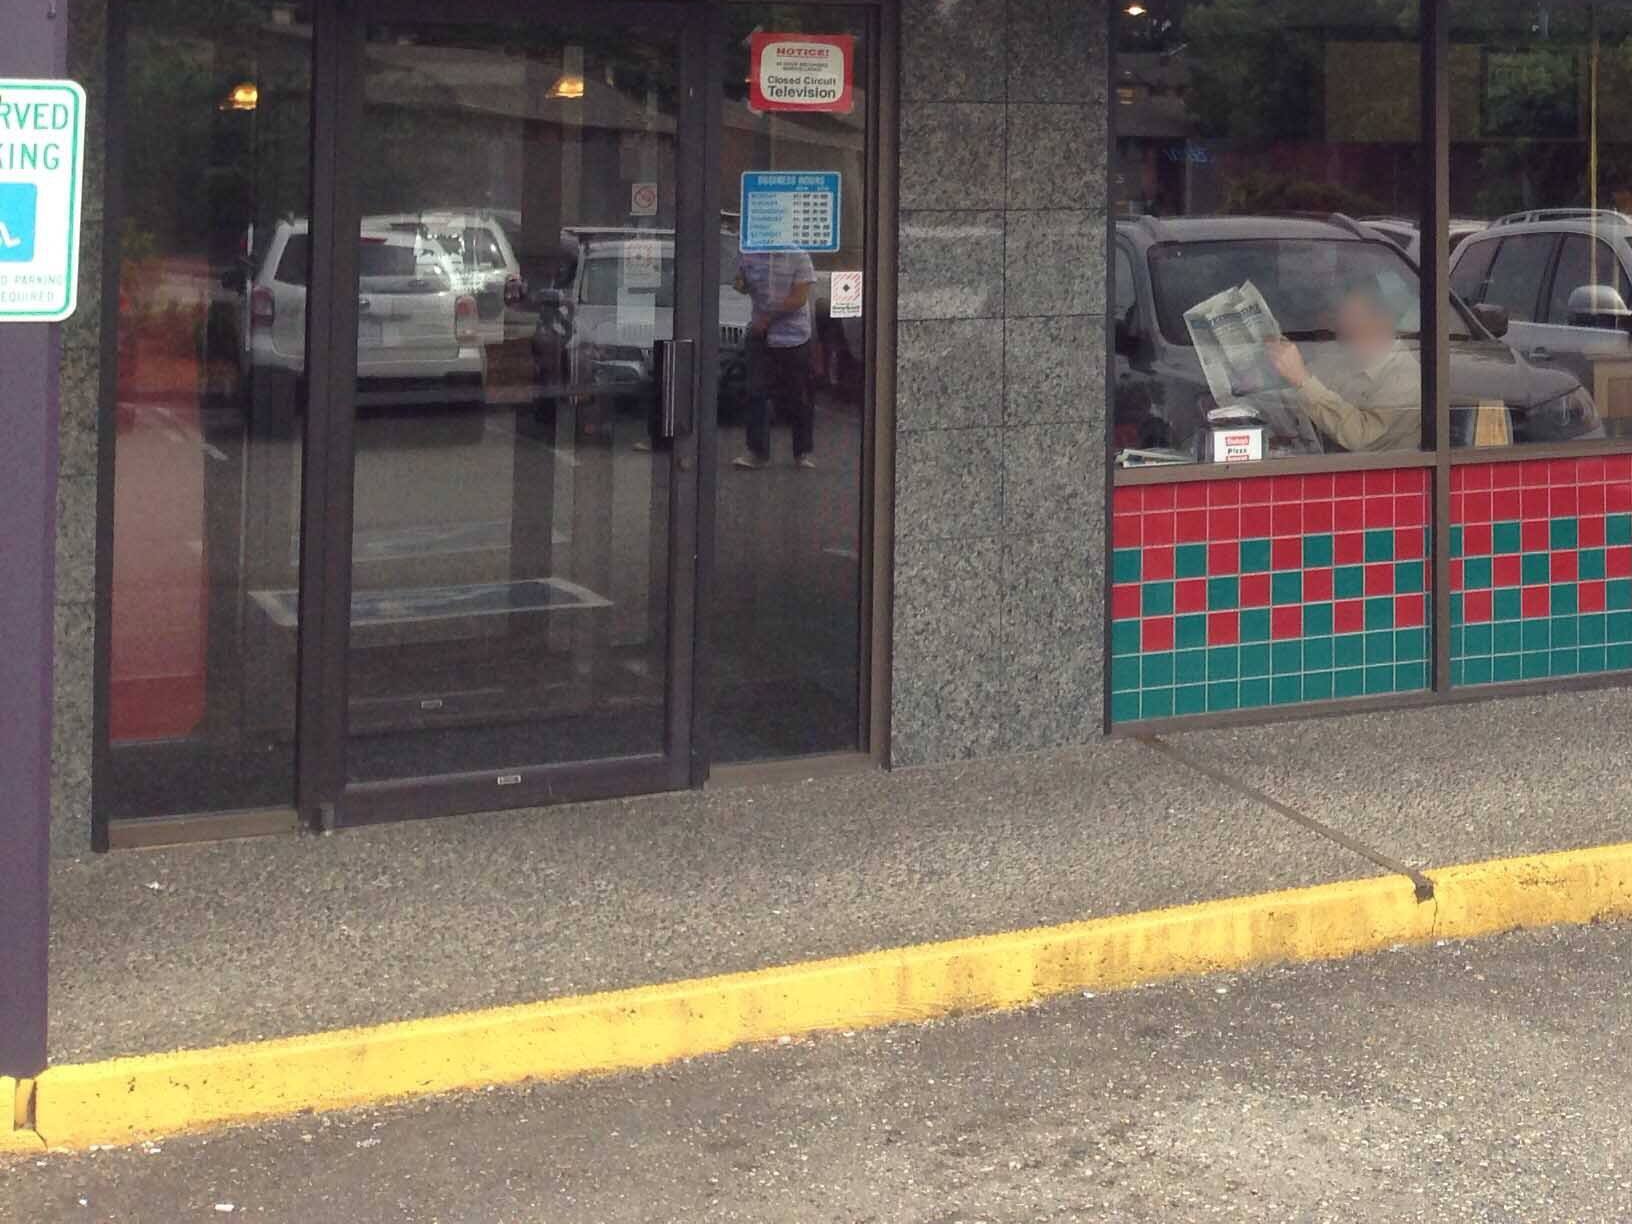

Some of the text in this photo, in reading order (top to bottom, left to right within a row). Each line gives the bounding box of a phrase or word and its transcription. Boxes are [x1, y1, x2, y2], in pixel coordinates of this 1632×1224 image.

[767, 75, 837, 86] Closed Circuit
[767, 85, 837, 99] Television
